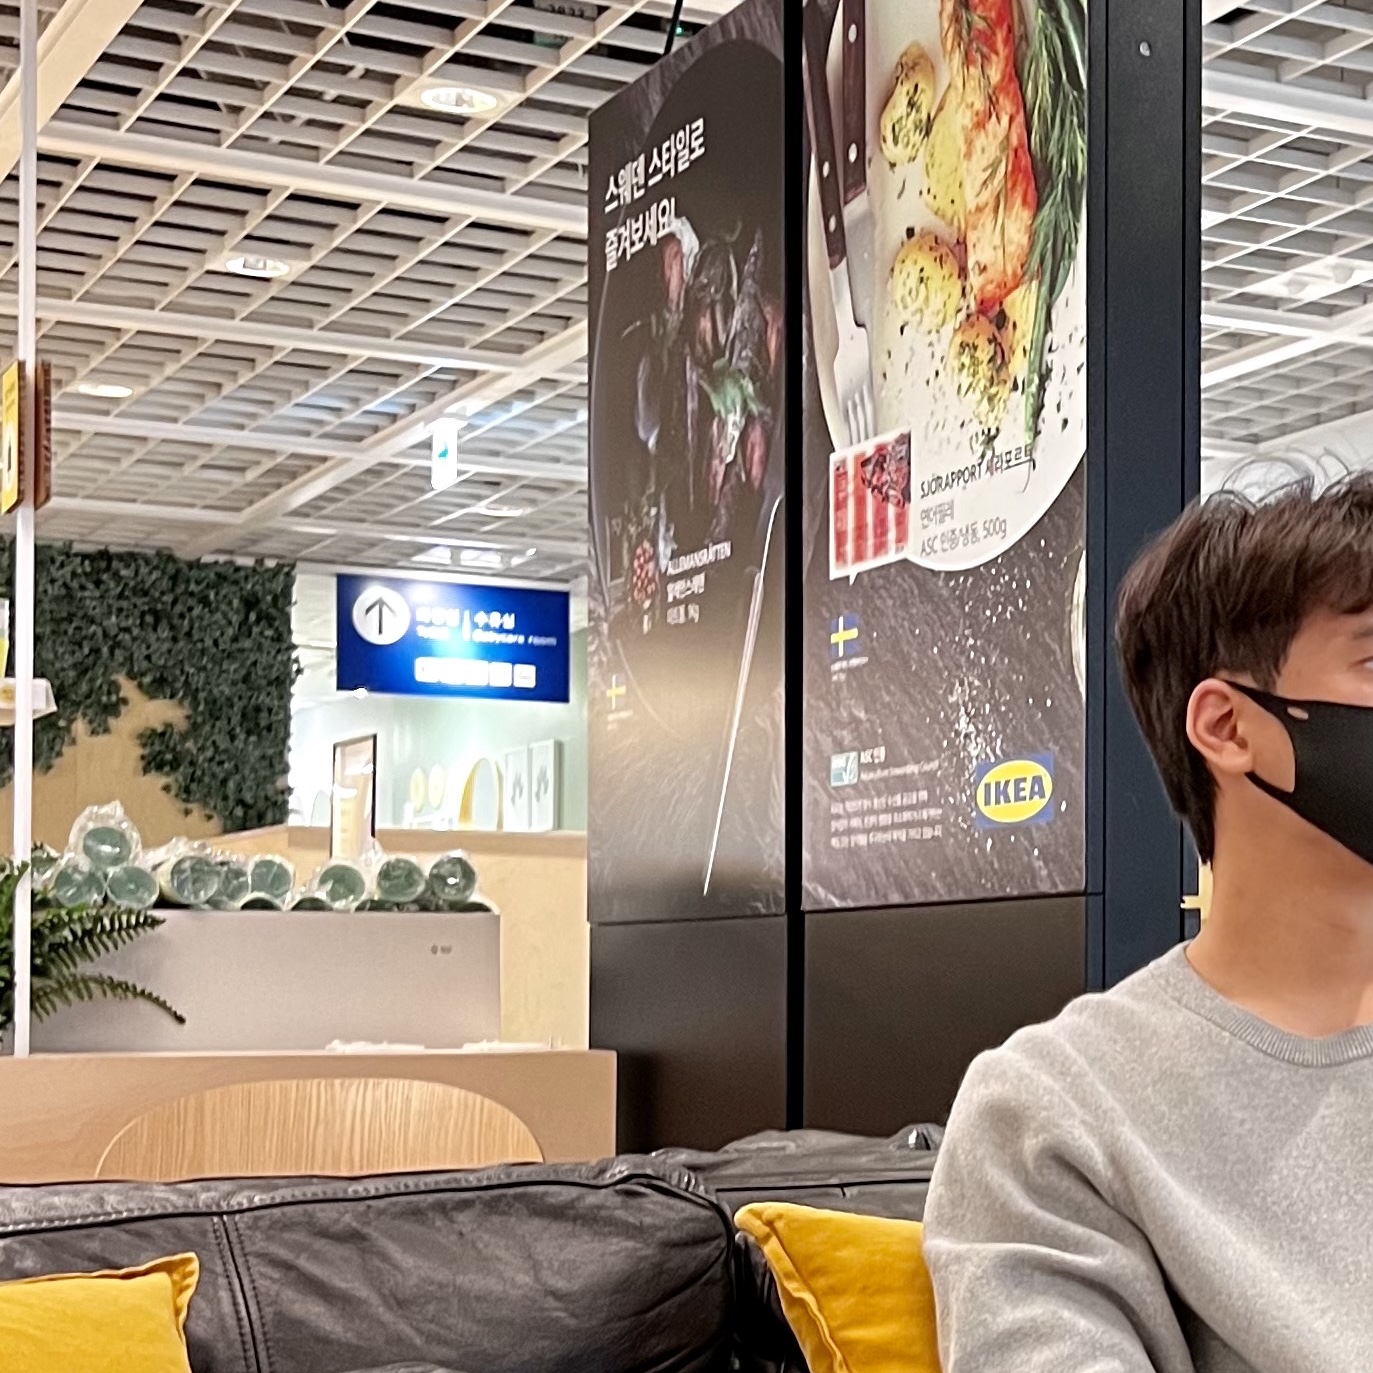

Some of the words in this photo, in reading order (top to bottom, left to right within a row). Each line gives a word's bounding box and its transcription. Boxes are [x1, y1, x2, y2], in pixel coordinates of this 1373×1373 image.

[605, 153, 645, 213] 스웨덴
[648, 118, 705, 186] 스타일로
[920, 536, 938, 556] ASC
[983, 517, 1007, 539] 500g
[984, 775, 1046, 806] IKEA
